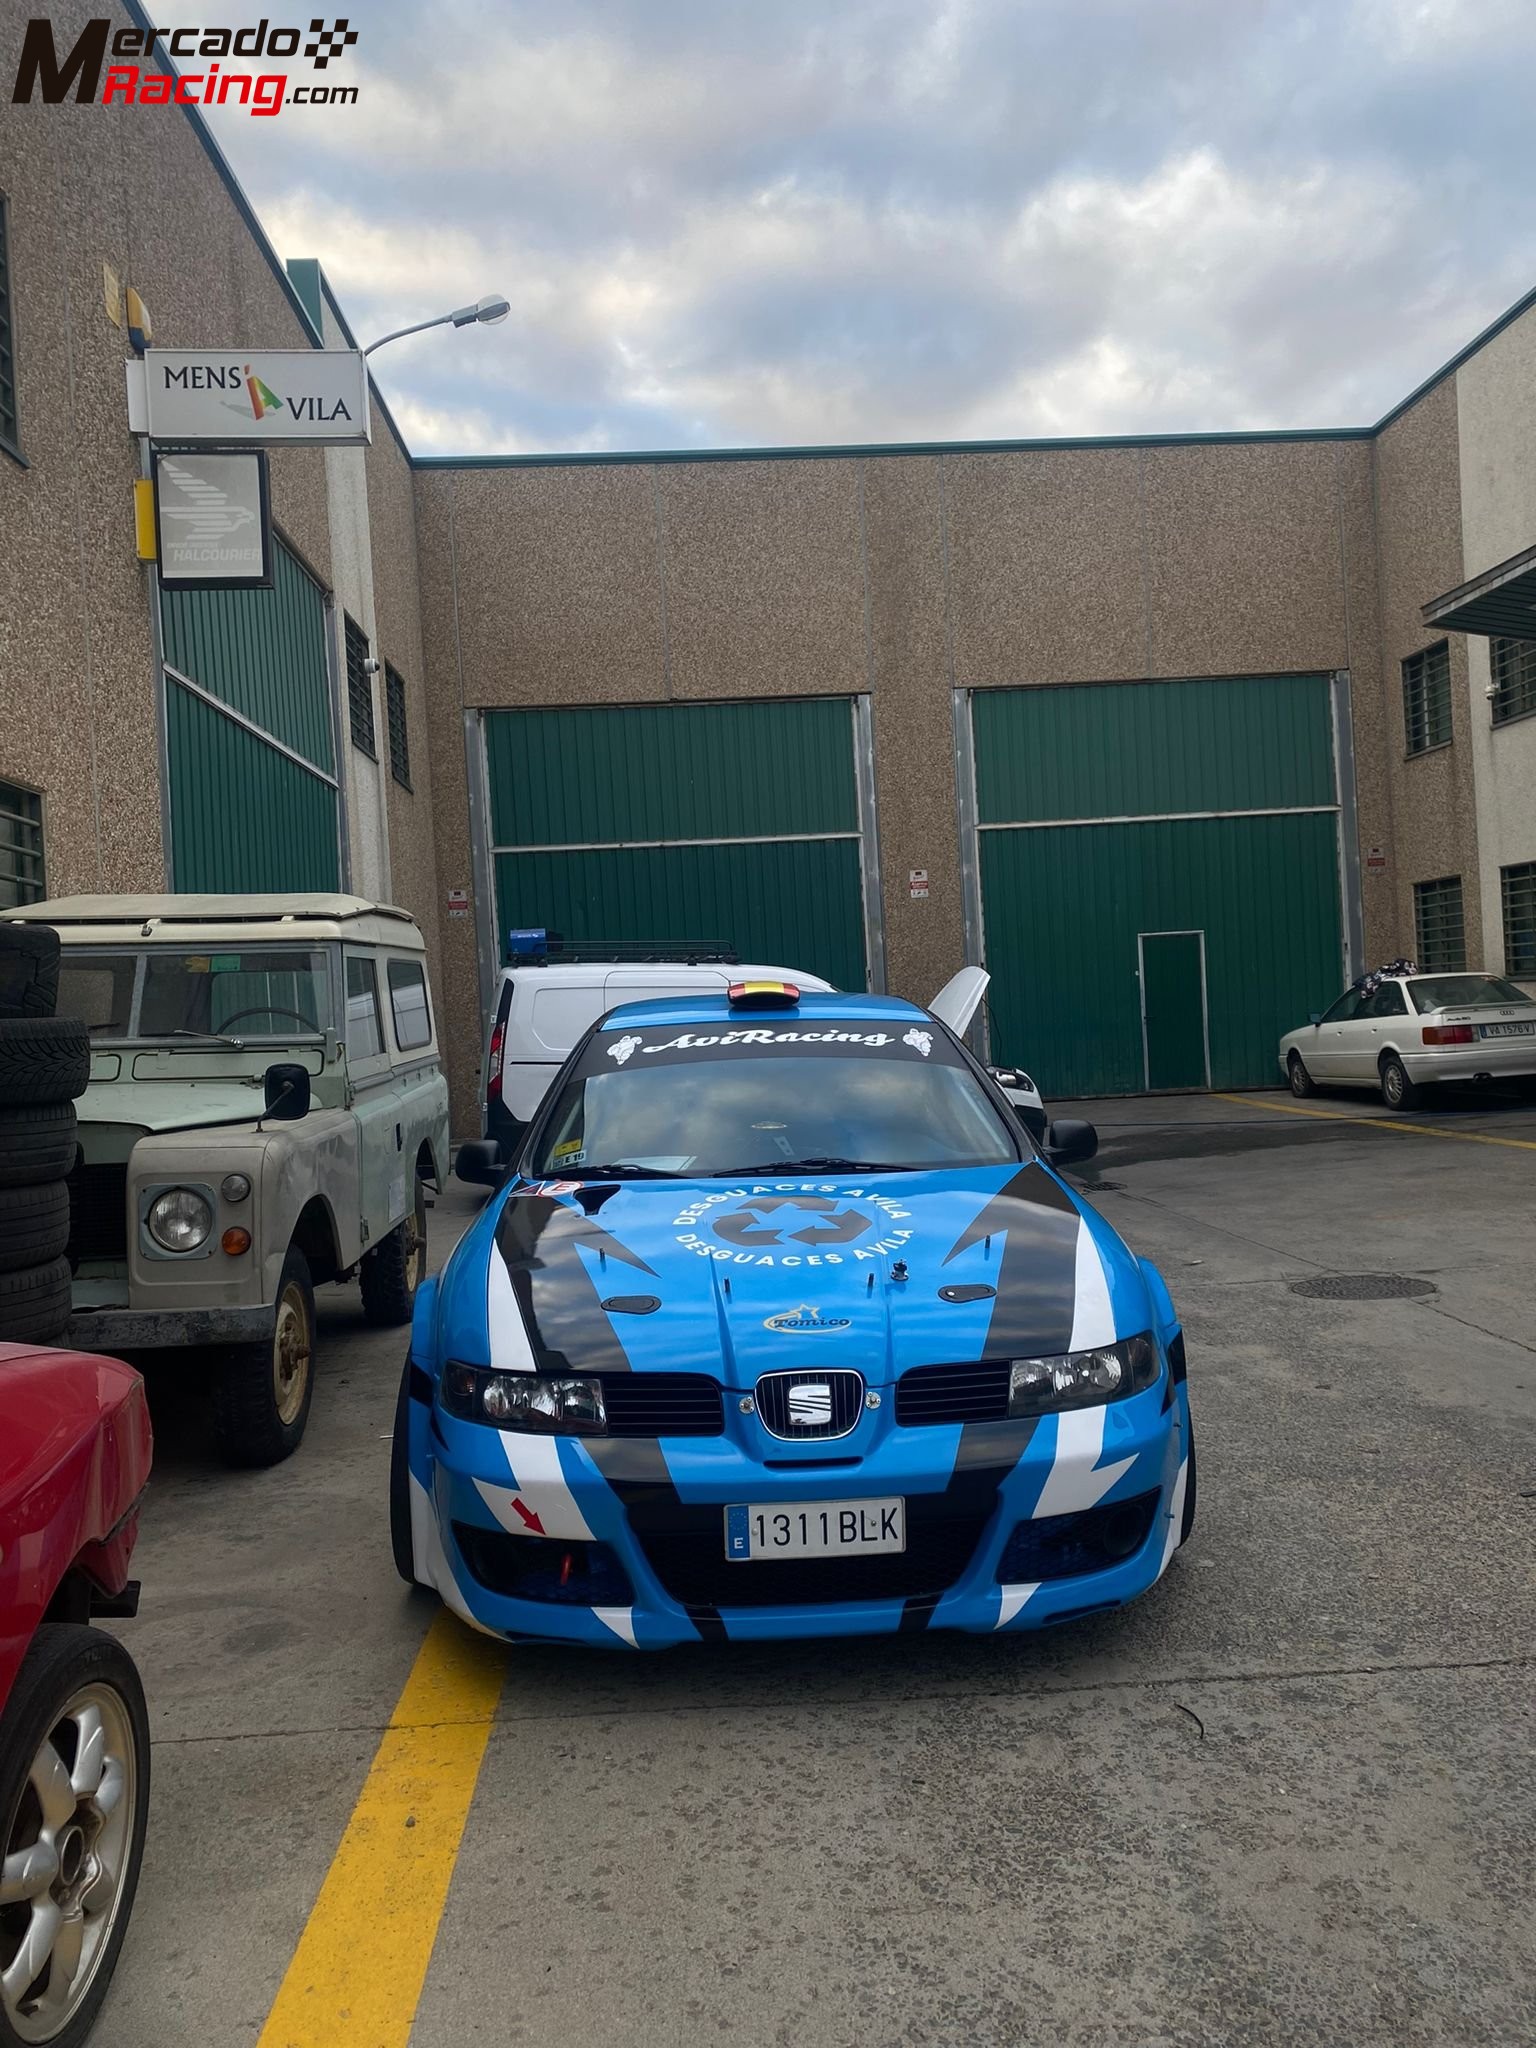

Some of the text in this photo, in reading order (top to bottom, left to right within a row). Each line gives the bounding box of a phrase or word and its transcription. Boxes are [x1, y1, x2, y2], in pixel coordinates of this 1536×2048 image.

[174, 548, 260, 561] HALCOURIER
[642, 1029, 896, 1053] AviRacing
[672, 1183, 913, 1226] DESGUACES AVILA
[675, 1228, 914, 1266] DESGUACES AVILA
[733, 1537, 744, 1549] E
